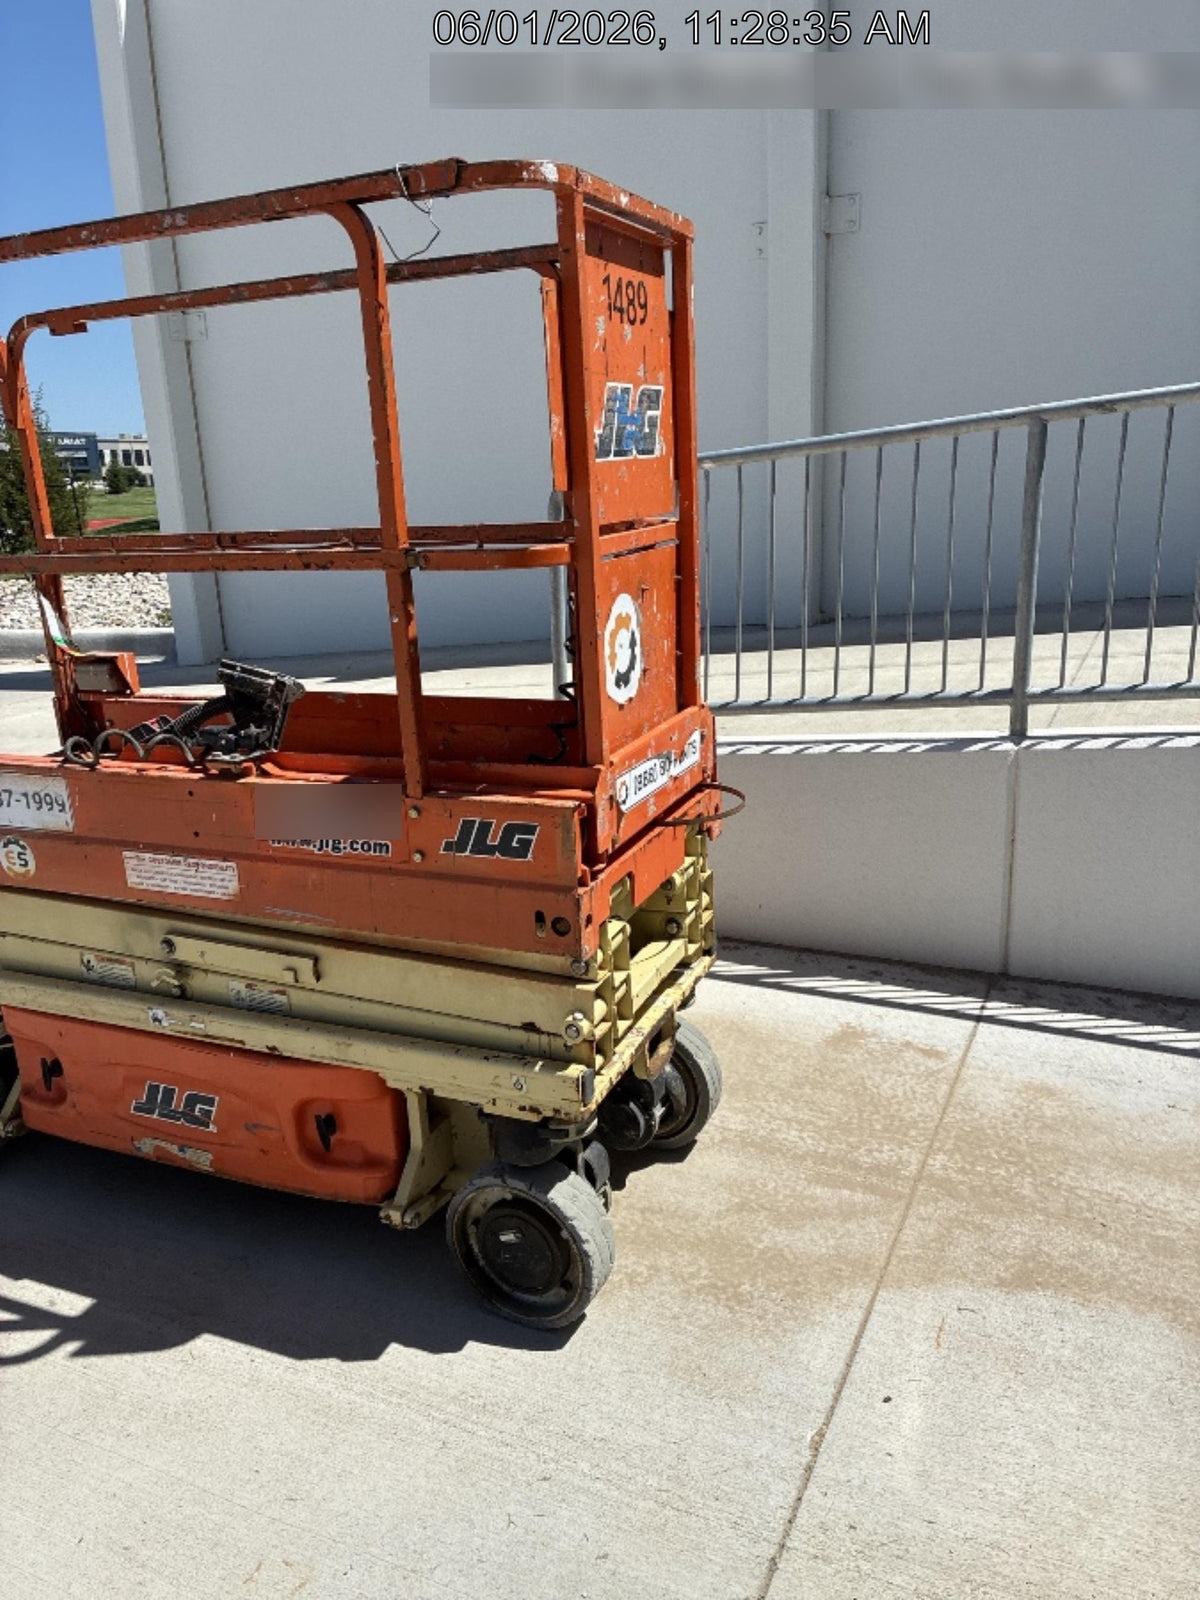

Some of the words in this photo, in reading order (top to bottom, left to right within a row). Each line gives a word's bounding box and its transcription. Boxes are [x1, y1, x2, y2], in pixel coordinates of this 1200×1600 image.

[602, 273, 648, 326] 1489
[441, 817, 540, 861] JLG
[131, 1081, 218, 1132] JLG
